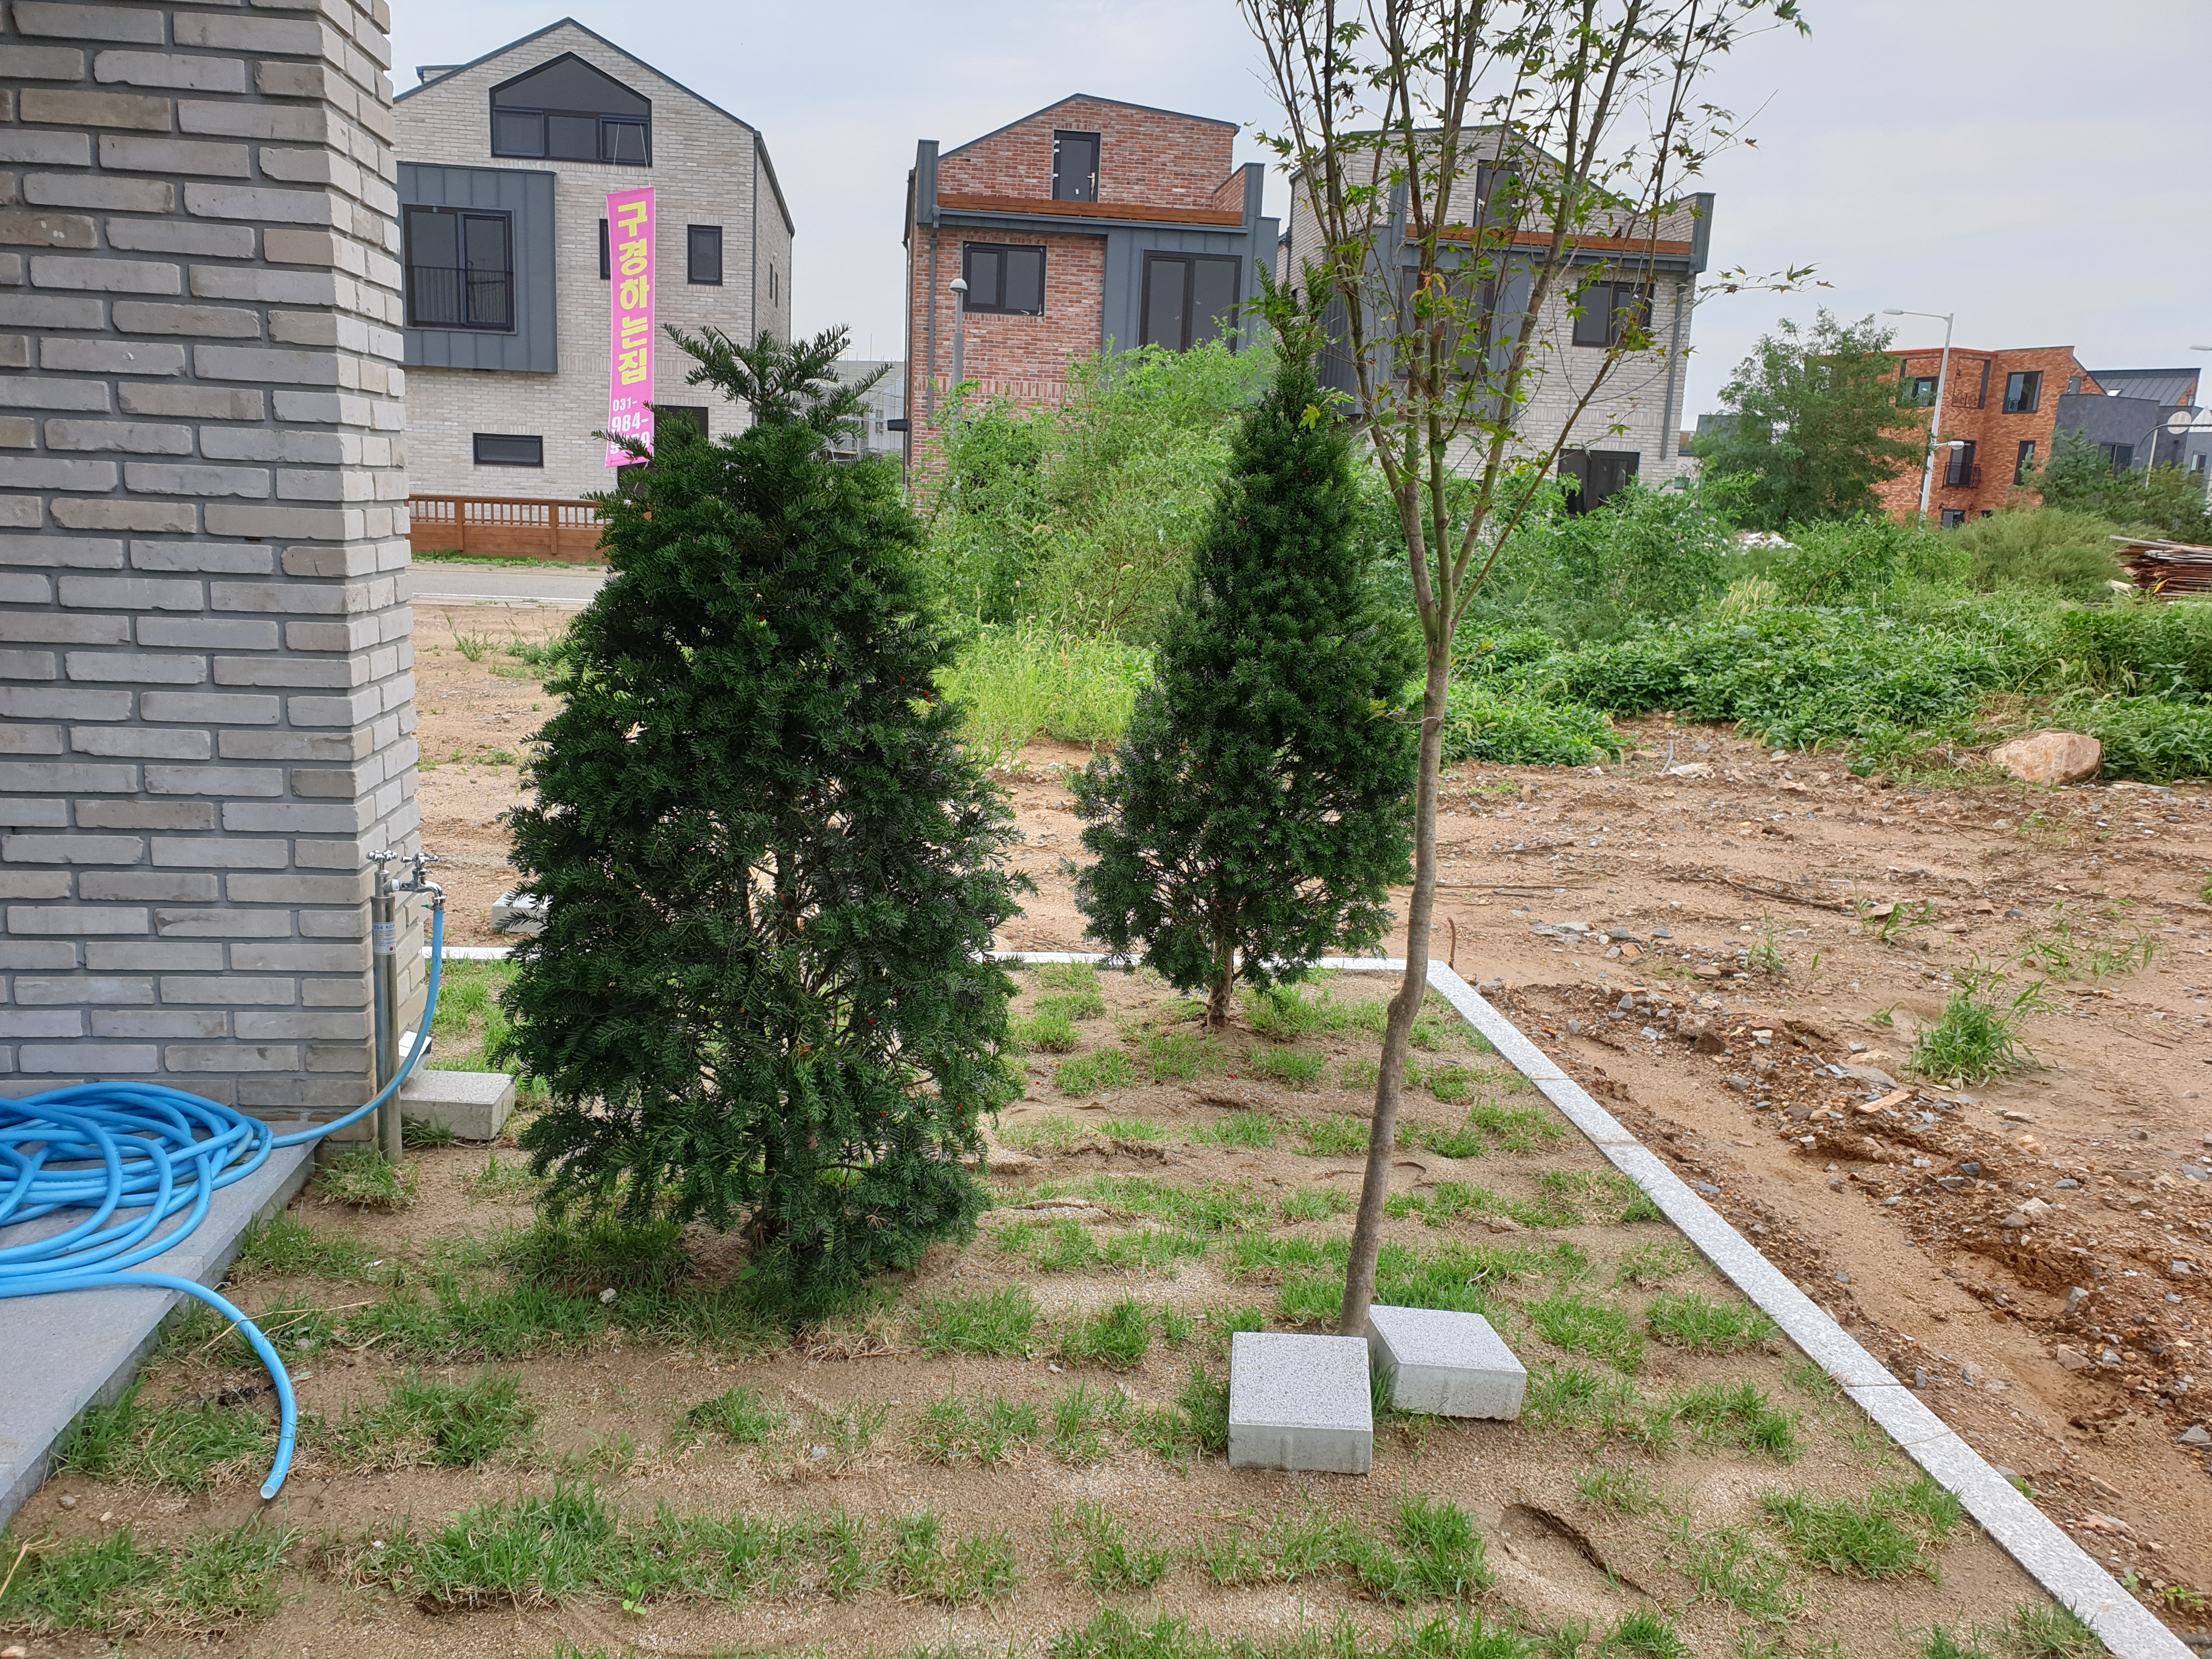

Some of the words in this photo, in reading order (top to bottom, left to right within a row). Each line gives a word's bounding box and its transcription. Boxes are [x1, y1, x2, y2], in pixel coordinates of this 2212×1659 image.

[618, 201, 650, 385] 구경하는집
[613, 396, 638, 412] 031-
[611, 411, 649, 435] 984-
